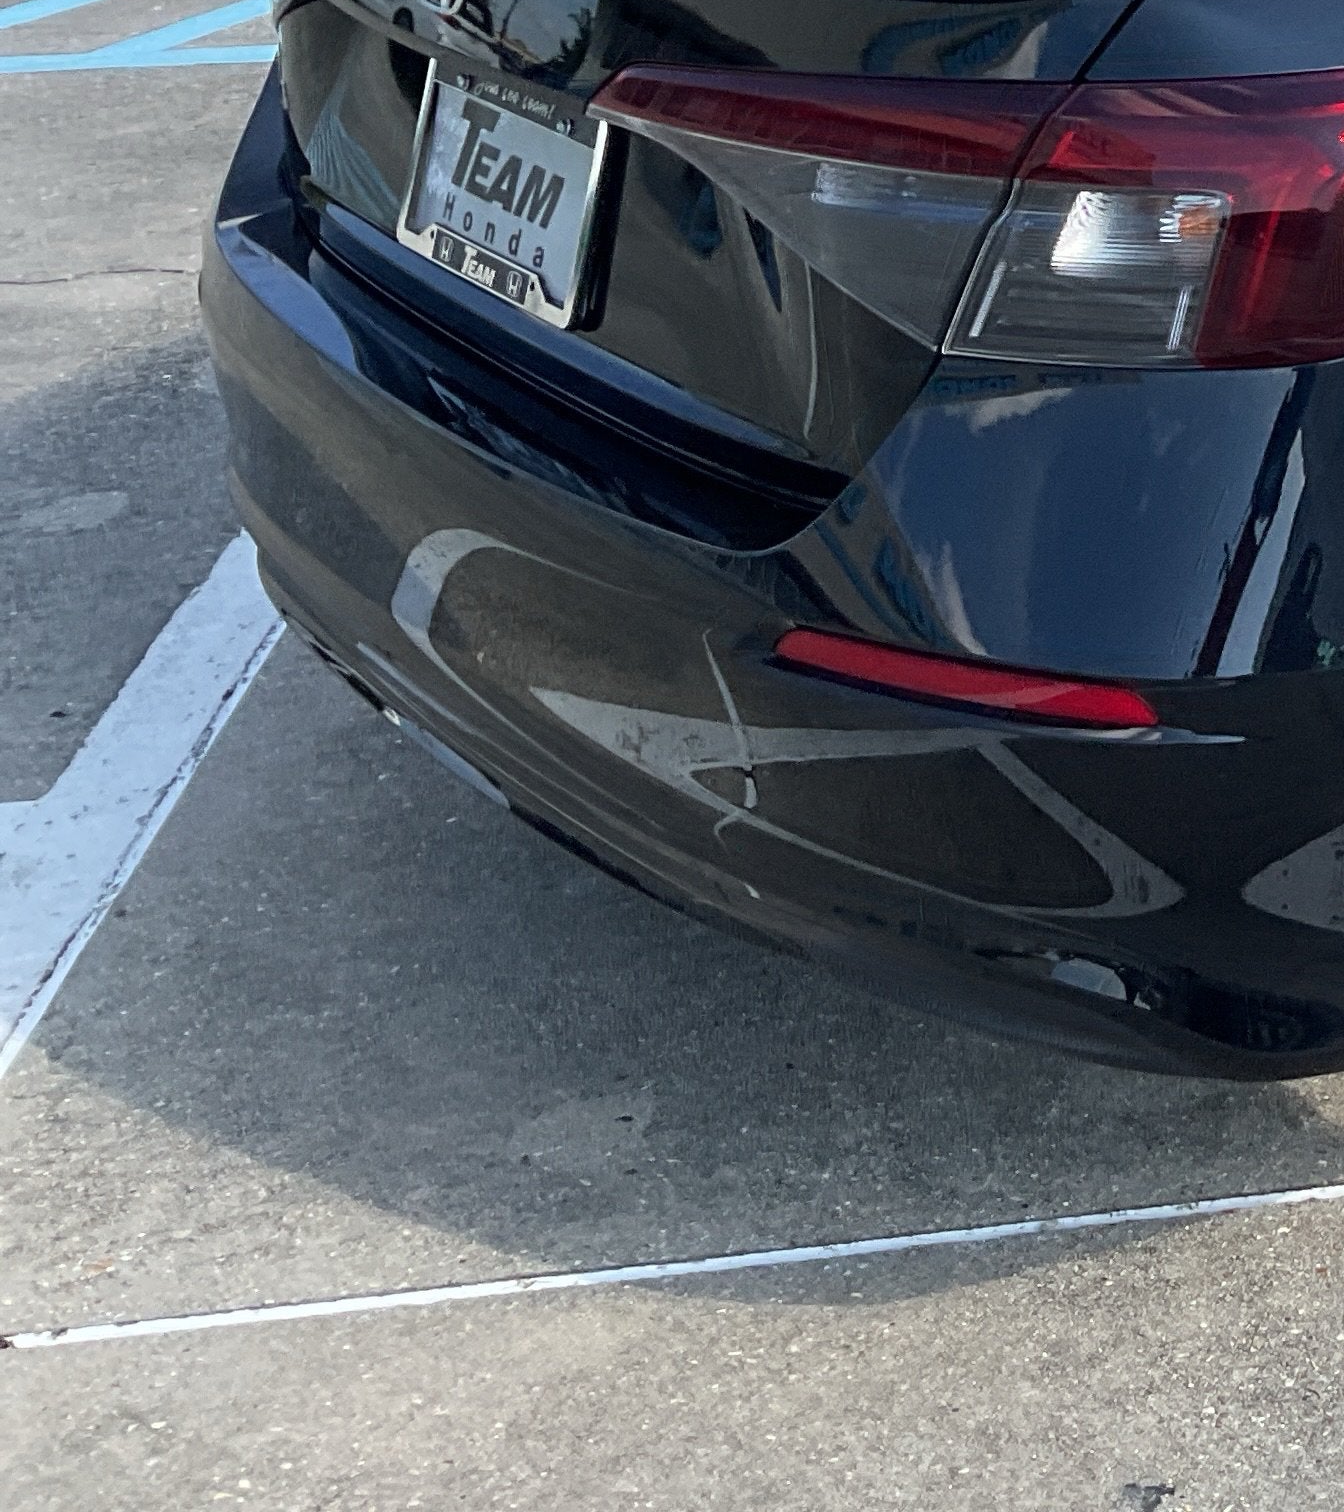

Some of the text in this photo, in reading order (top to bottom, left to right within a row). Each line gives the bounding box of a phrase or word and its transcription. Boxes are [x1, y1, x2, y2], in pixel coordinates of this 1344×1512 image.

[451, 98, 565, 230] TEAM
[443, 194, 545, 269] Honda
[460, 246, 497, 288] TEAM
